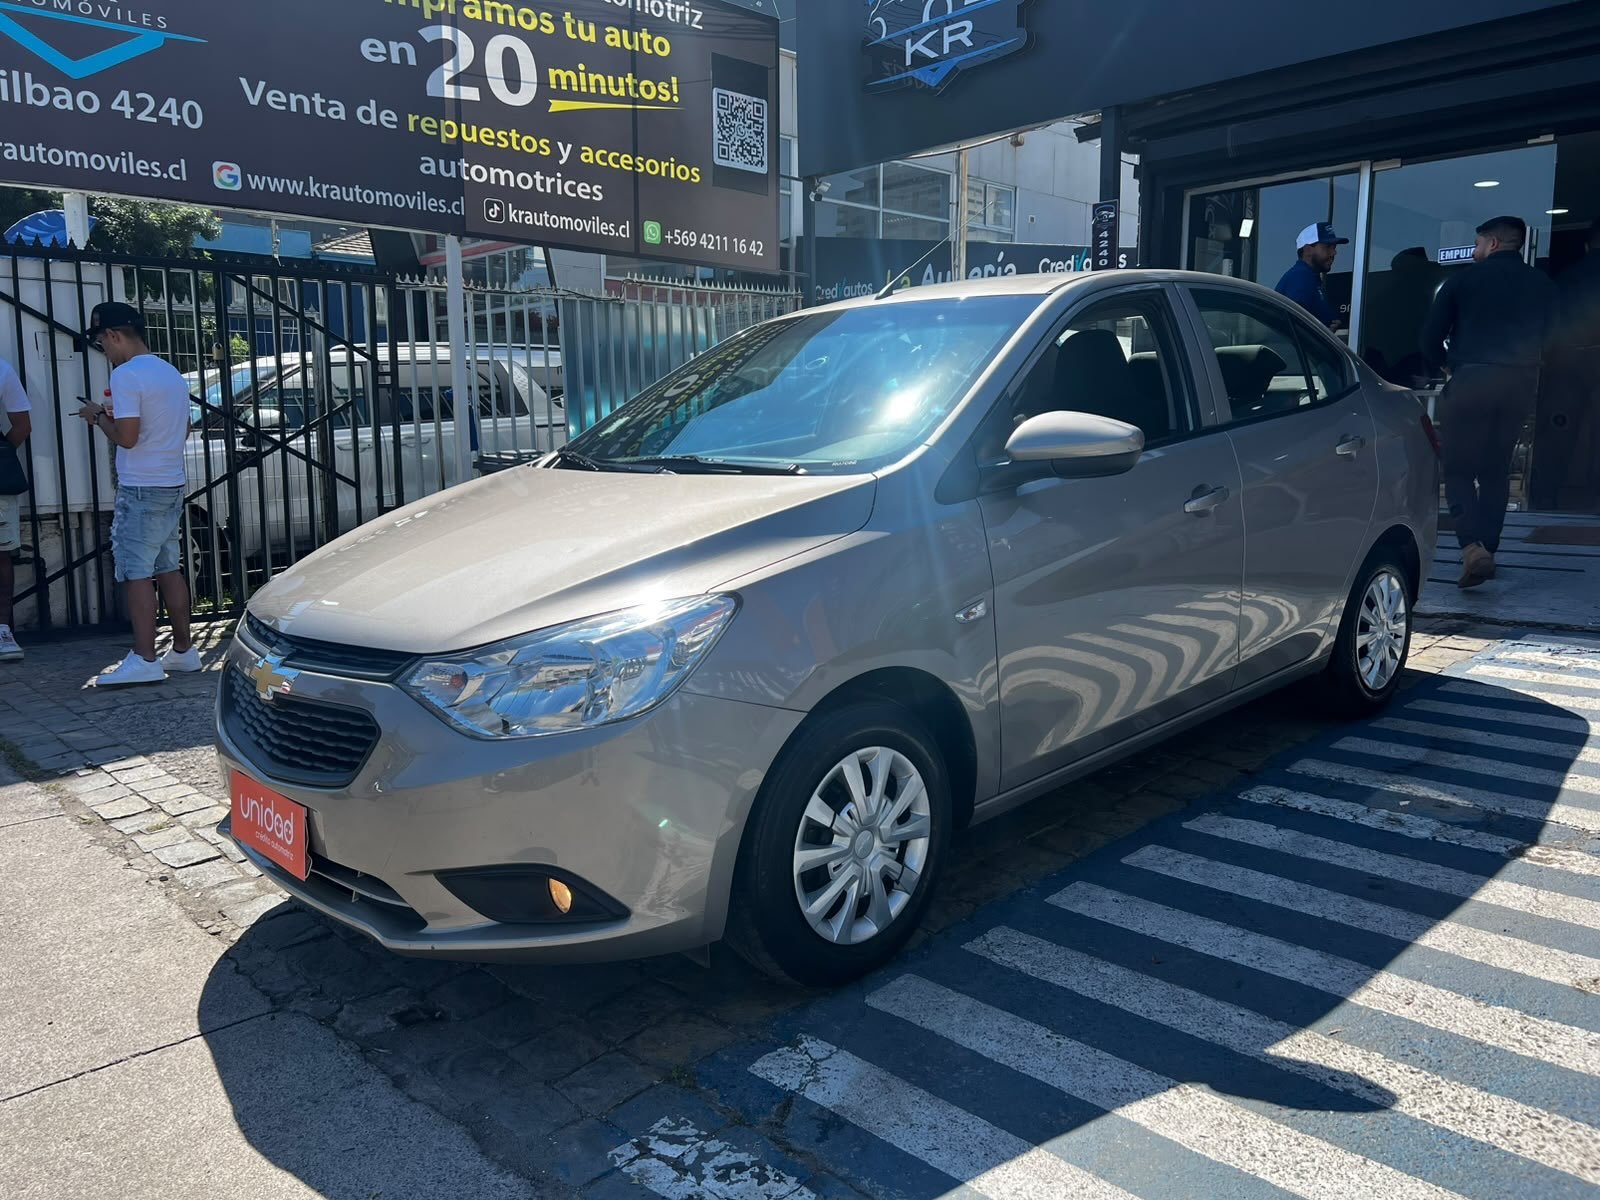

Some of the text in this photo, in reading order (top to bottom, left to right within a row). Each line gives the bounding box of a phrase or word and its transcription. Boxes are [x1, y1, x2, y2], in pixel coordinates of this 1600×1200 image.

[384, 0, 671, 57] pramos tu auto
[905, 20, 974, 66] KR
[360, 24, 680, 107] en 20 minutos!
[110, 89, 203, 129] 4240
[239, 77, 701, 183] Venta de repuestos y accesorios
[0, 141, 187, 181] automoviles.cl
[419, 155, 604, 201] automotrices
[247, 172, 465, 216] www.krautomoviles.cl
[508, 203, 630, 239] krautomoviles.cl
[665, 229, 764, 257] +569 4211 16 42
[1098, 230, 1109, 266] 4240
[240, 793, 294, 845] unidad
